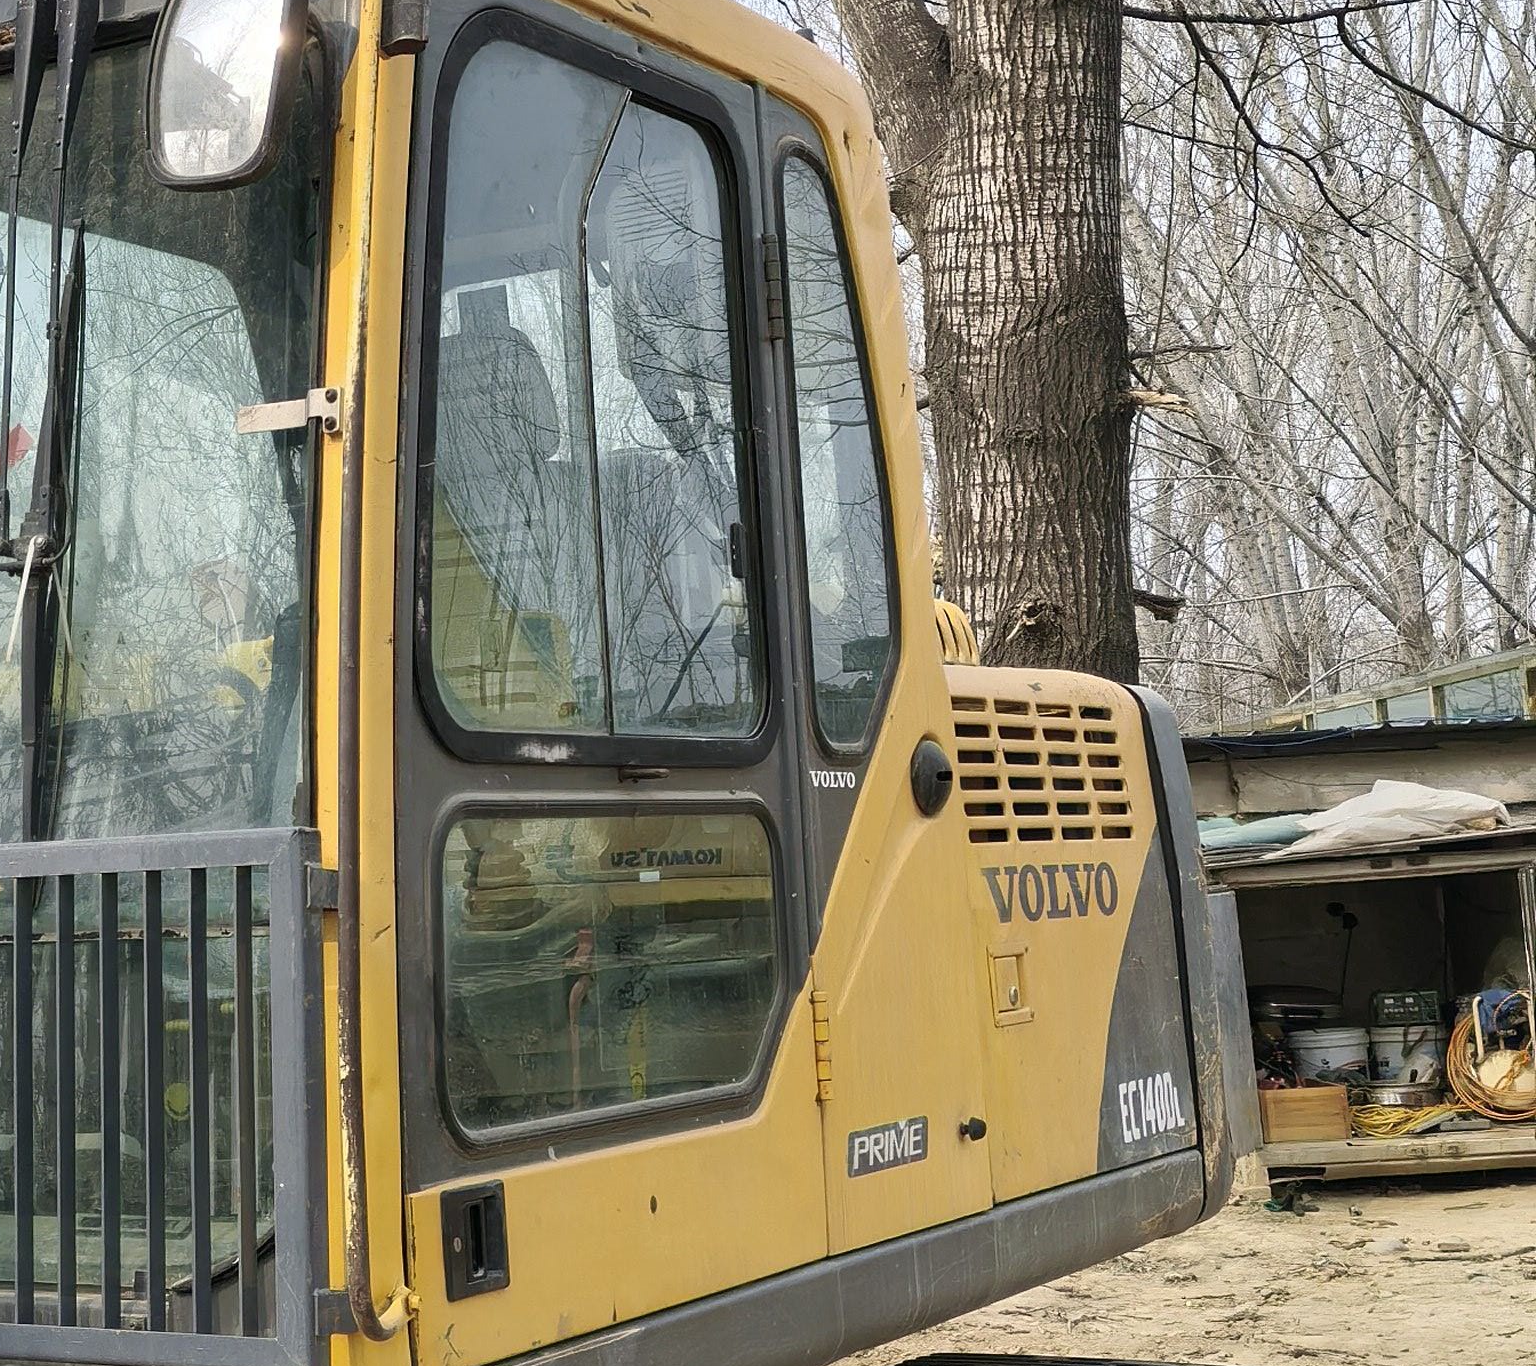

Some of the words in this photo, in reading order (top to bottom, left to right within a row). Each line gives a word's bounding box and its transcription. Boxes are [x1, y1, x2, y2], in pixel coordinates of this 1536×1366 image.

[809, 770, 856, 789] VOLVO
[980, 861, 1119, 924] VOLVO
[853, 1122, 924, 1170] PRIME
